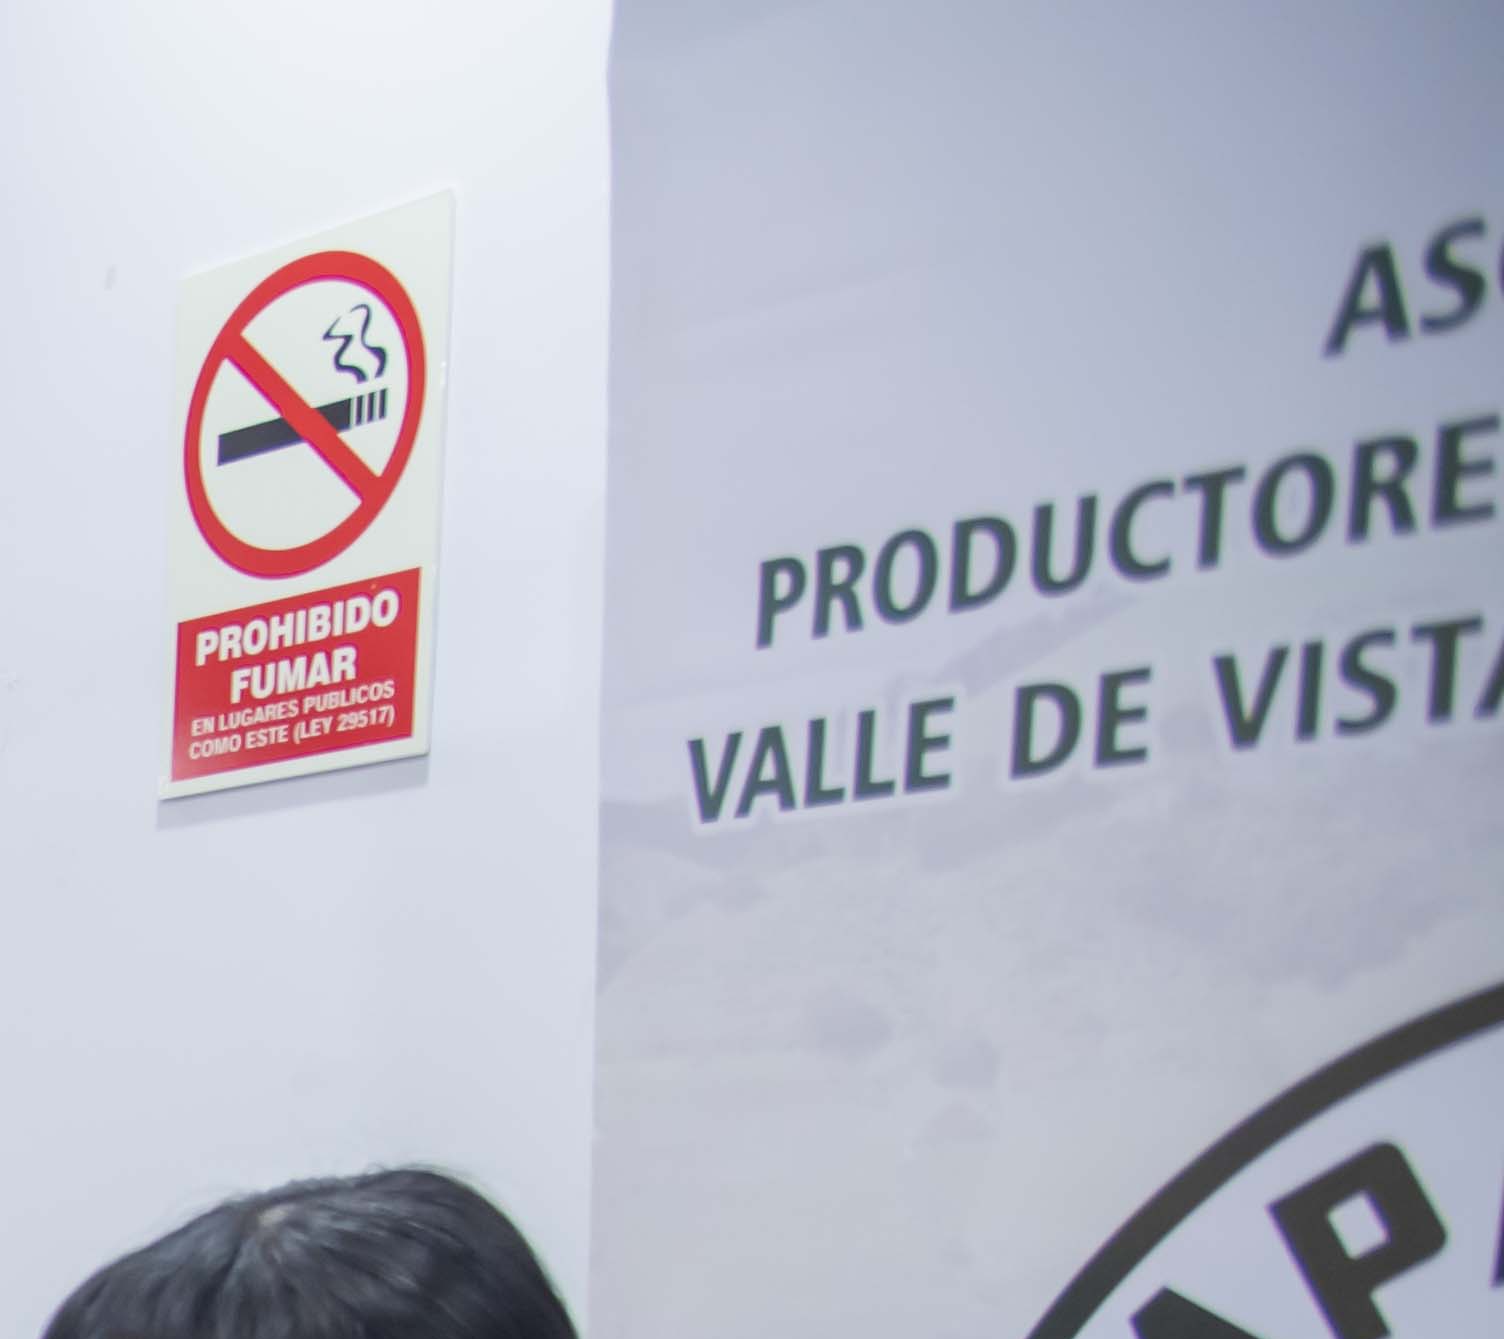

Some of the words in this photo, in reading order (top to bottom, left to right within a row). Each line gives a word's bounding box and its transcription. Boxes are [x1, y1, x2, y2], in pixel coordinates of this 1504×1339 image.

[1321, 214, 1504, 361] AS
[754, 413, 1502, 650] PRODUCTORE
[195, 589, 400, 667] PROHIBIDO
[191, 716, 215, 737] EN
[218, 699, 299, 731] LUGARES
[302, 680, 396, 714] PUBLICOS
[230, 646, 357, 704] FUMAR
[188, 734, 241, 760] COMO
[245, 724, 289, 749] ESTE
[292, 716, 333, 745] (LEY
[336, 704, 396, 732] 29517)
[686, 696, 956, 825] VALLE
[1008, 666, 1152, 781] DE
